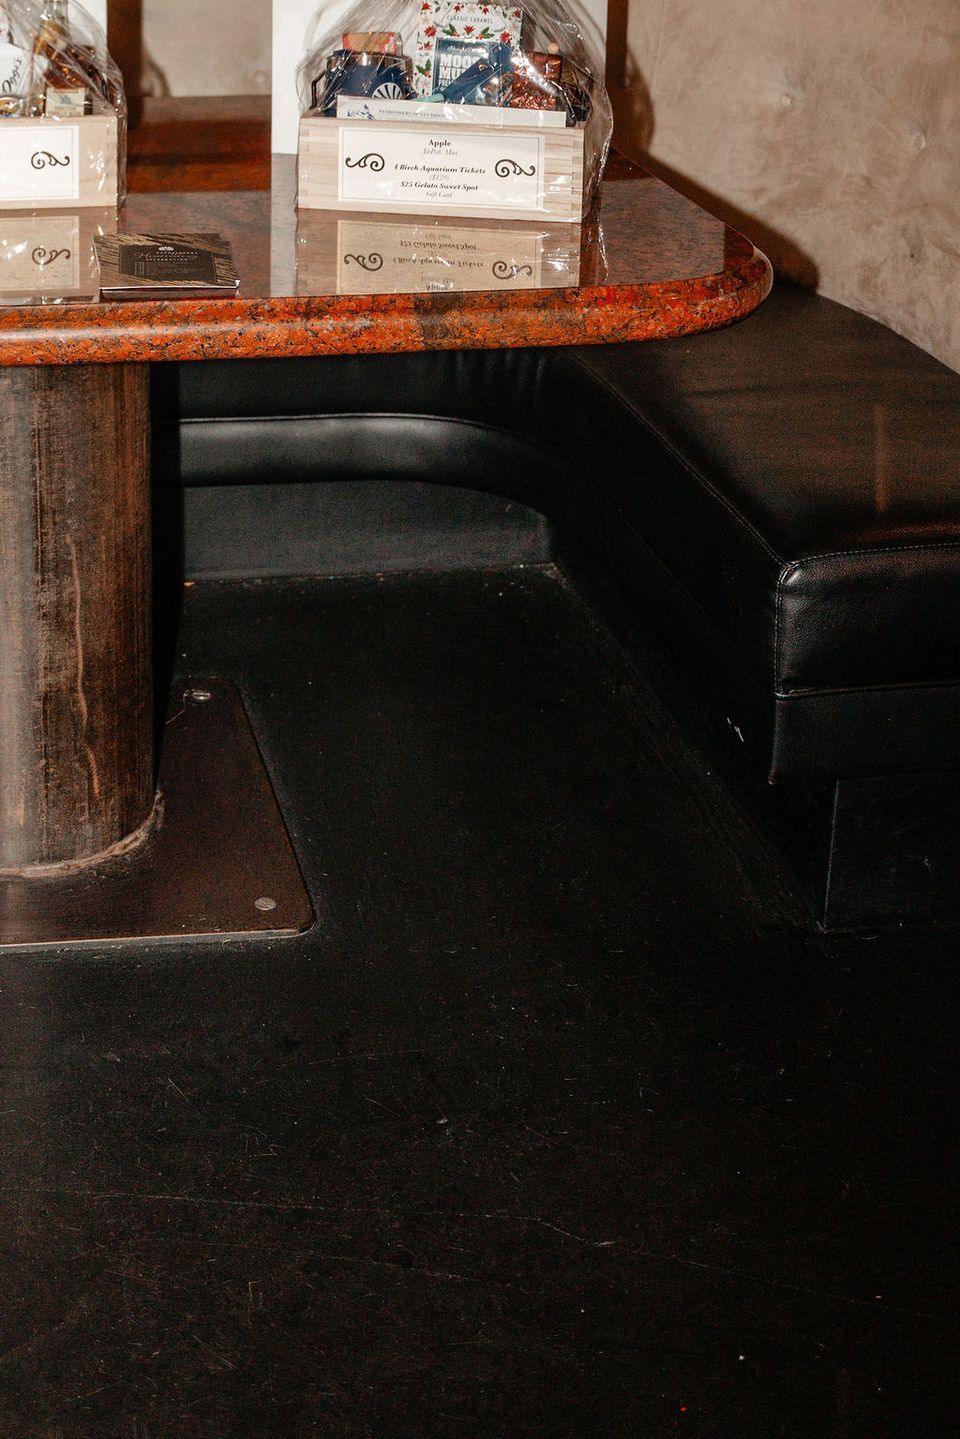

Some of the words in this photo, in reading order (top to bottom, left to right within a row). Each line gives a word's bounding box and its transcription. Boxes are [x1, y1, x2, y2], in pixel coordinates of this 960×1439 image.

[439, 54, 480, 69] MOO
[428, 139, 452, 148] Apple
[420, 165, 458, 173] Aquarium
[459, 166, 486, 174] Tickets
[414, 181, 438, 189] Gelato
[461, 184, 479, 192] Spot
